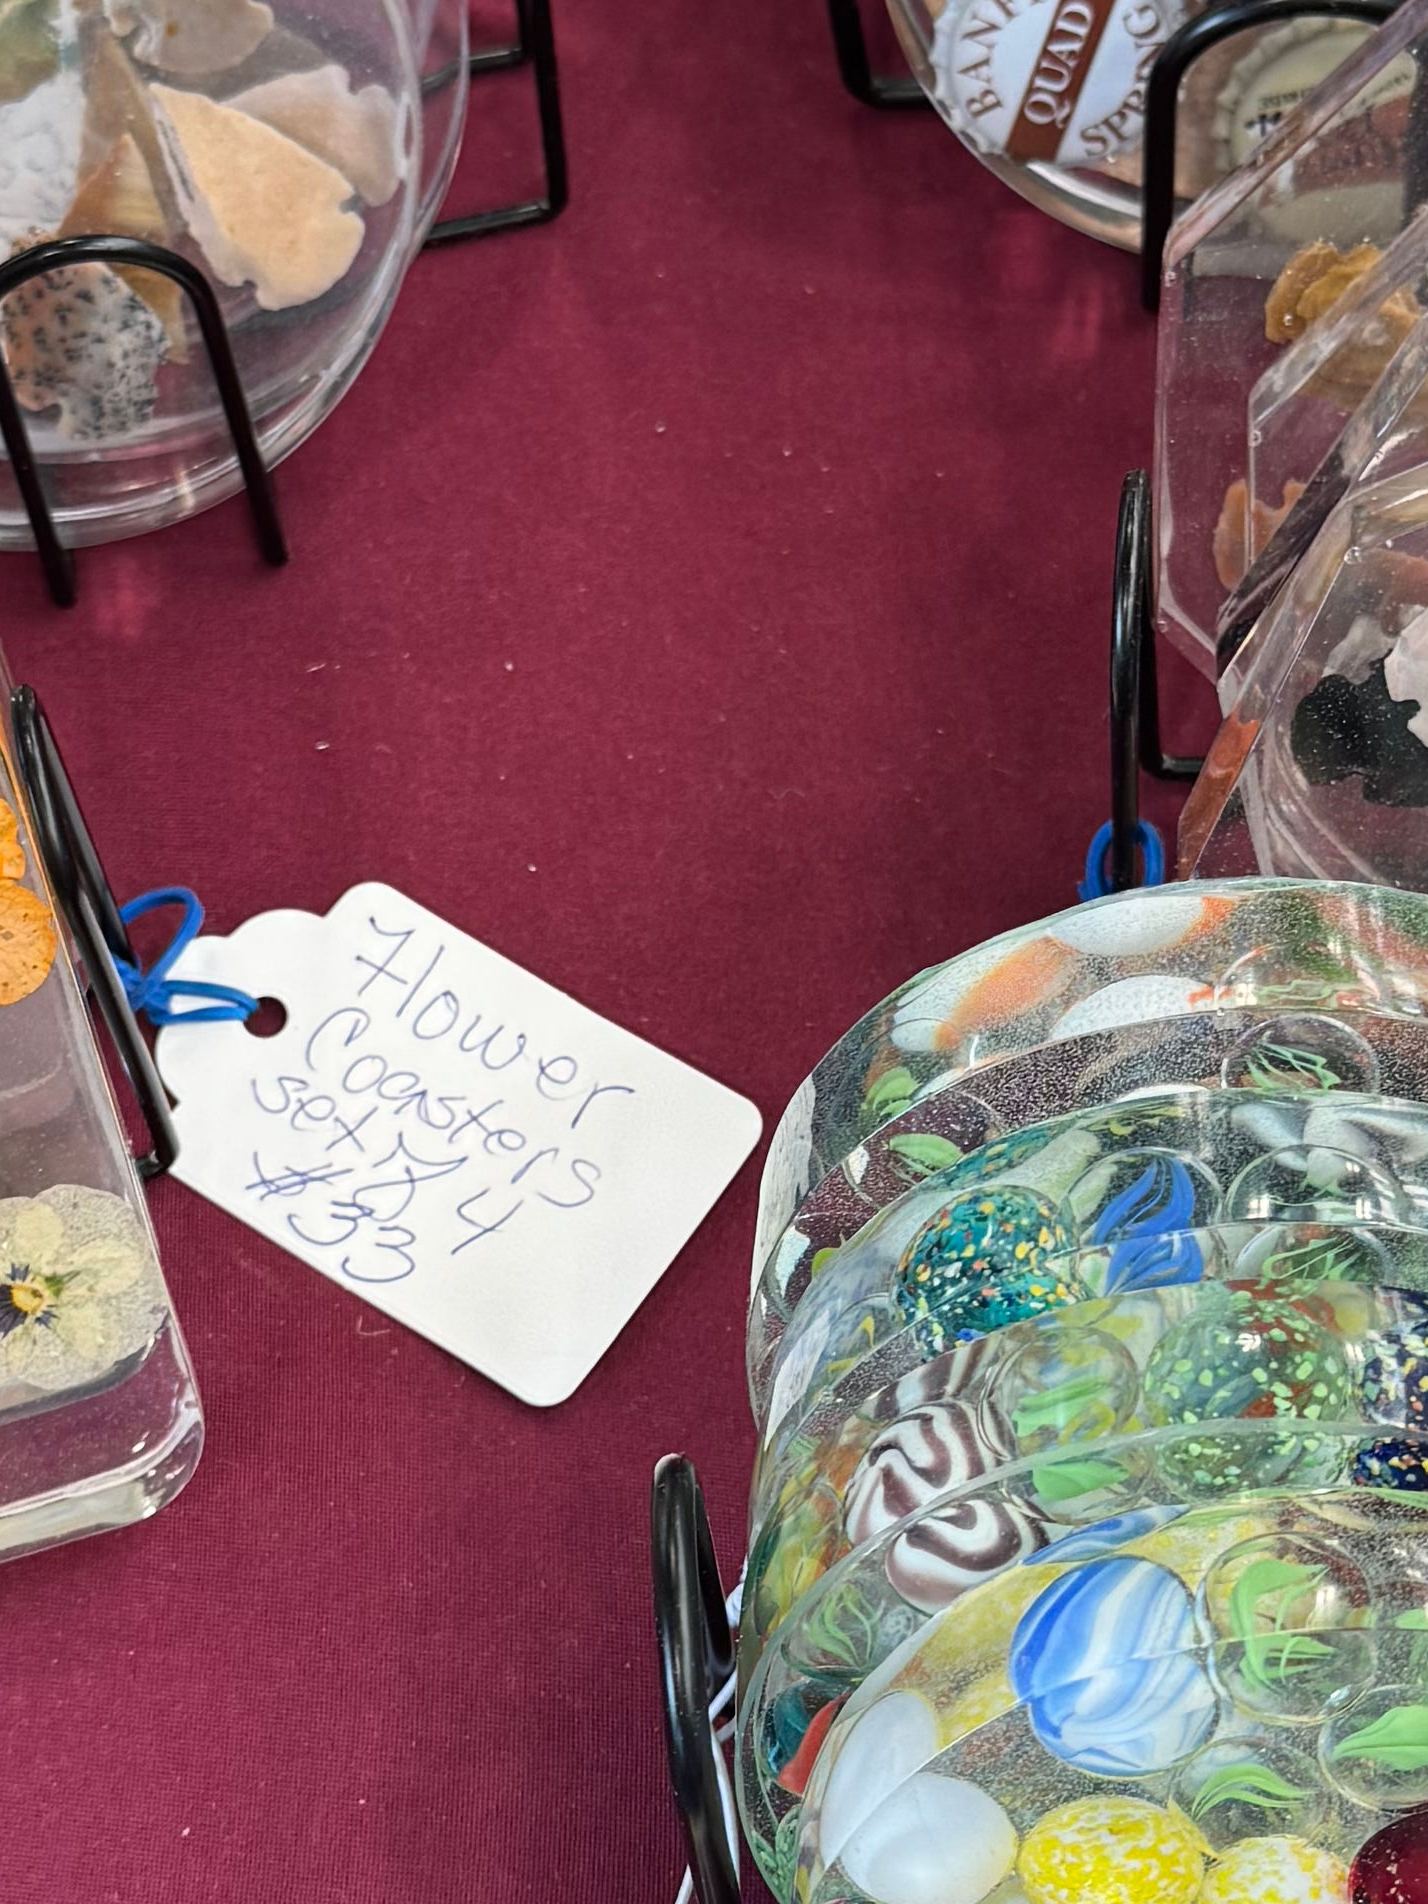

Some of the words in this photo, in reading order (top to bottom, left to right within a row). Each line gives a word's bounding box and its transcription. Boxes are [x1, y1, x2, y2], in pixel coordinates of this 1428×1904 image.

[1023, 0, 1095, 129] QUAD
[306, 1007, 601, 1209] Coasters
[354, 915, 636, 1129] Flower
